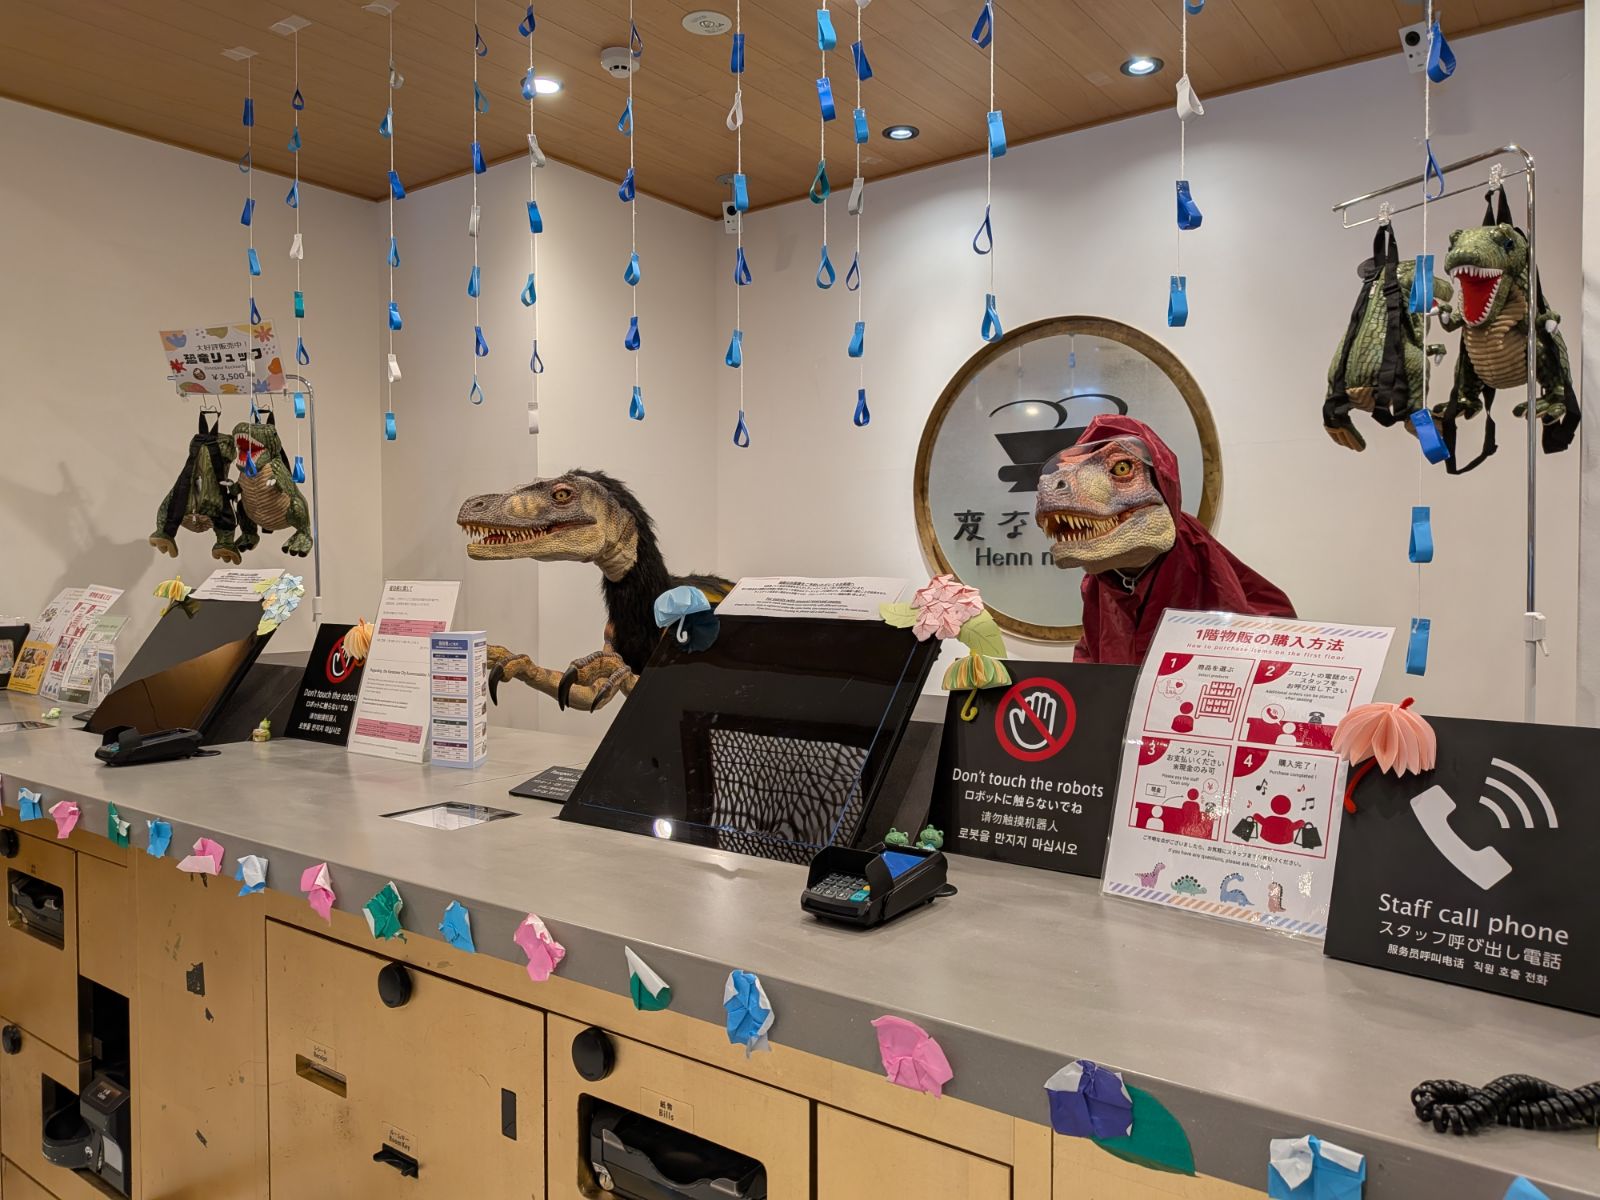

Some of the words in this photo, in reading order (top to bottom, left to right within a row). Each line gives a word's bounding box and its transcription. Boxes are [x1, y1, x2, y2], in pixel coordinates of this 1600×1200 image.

[211, 372, 245, 382] ¥3,500
[976, 547, 1032, 566] Henn
[1195, 629, 1345, 653] 1階物販の購入方法
[1214, 644, 1248, 653] purchase
[1170, 658, 1177, 668] 1
[1264, 666, 1275, 677] 2
[1288, 670, 1355, 682] フロントの電話から
[1286, 683, 1348, 694] お呼び出し下さい
[1300, 677, 1337, 687] スタッフを
[317, 690, 331, 700] touch
[332, 691, 341, 700] the
[1179, 747, 1215, 758] スタッフに
[1166, 754, 1225, 767] お支払いください
[1243, 754, 1253, 768] 4
[952, 768, 985, 784] Don't
[989, 772, 1026, 789] touch
[1031, 776, 1053, 792] the
[1057, 780, 1104, 798] robots
[964, 790, 1083, 814] ロボットに触らないでね
[981, 811, 1059, 833] 请勿触摸机器人
[958, 827, 991, 843] 로봇을
[994, 832, 1028, 849] 만지지
[1032, 838, 1078, 856] 마십시오
[1378, 893, 1434, 919] Staff
[1438, 907, 1479, 928] call
[1488, 915, 1569, 945] phone
[1379, 921, 1563, 970] スタッフ呼び出し電話
[1387, 943, 1465, 970] 服务员呼叫电话
[1473, 961, 1495, 975] 직원
[1498, 966, 1521, 981] 호출
[1525, 972, 1548, 986] 전화
[659, 1109, 674, 1121] Bills
